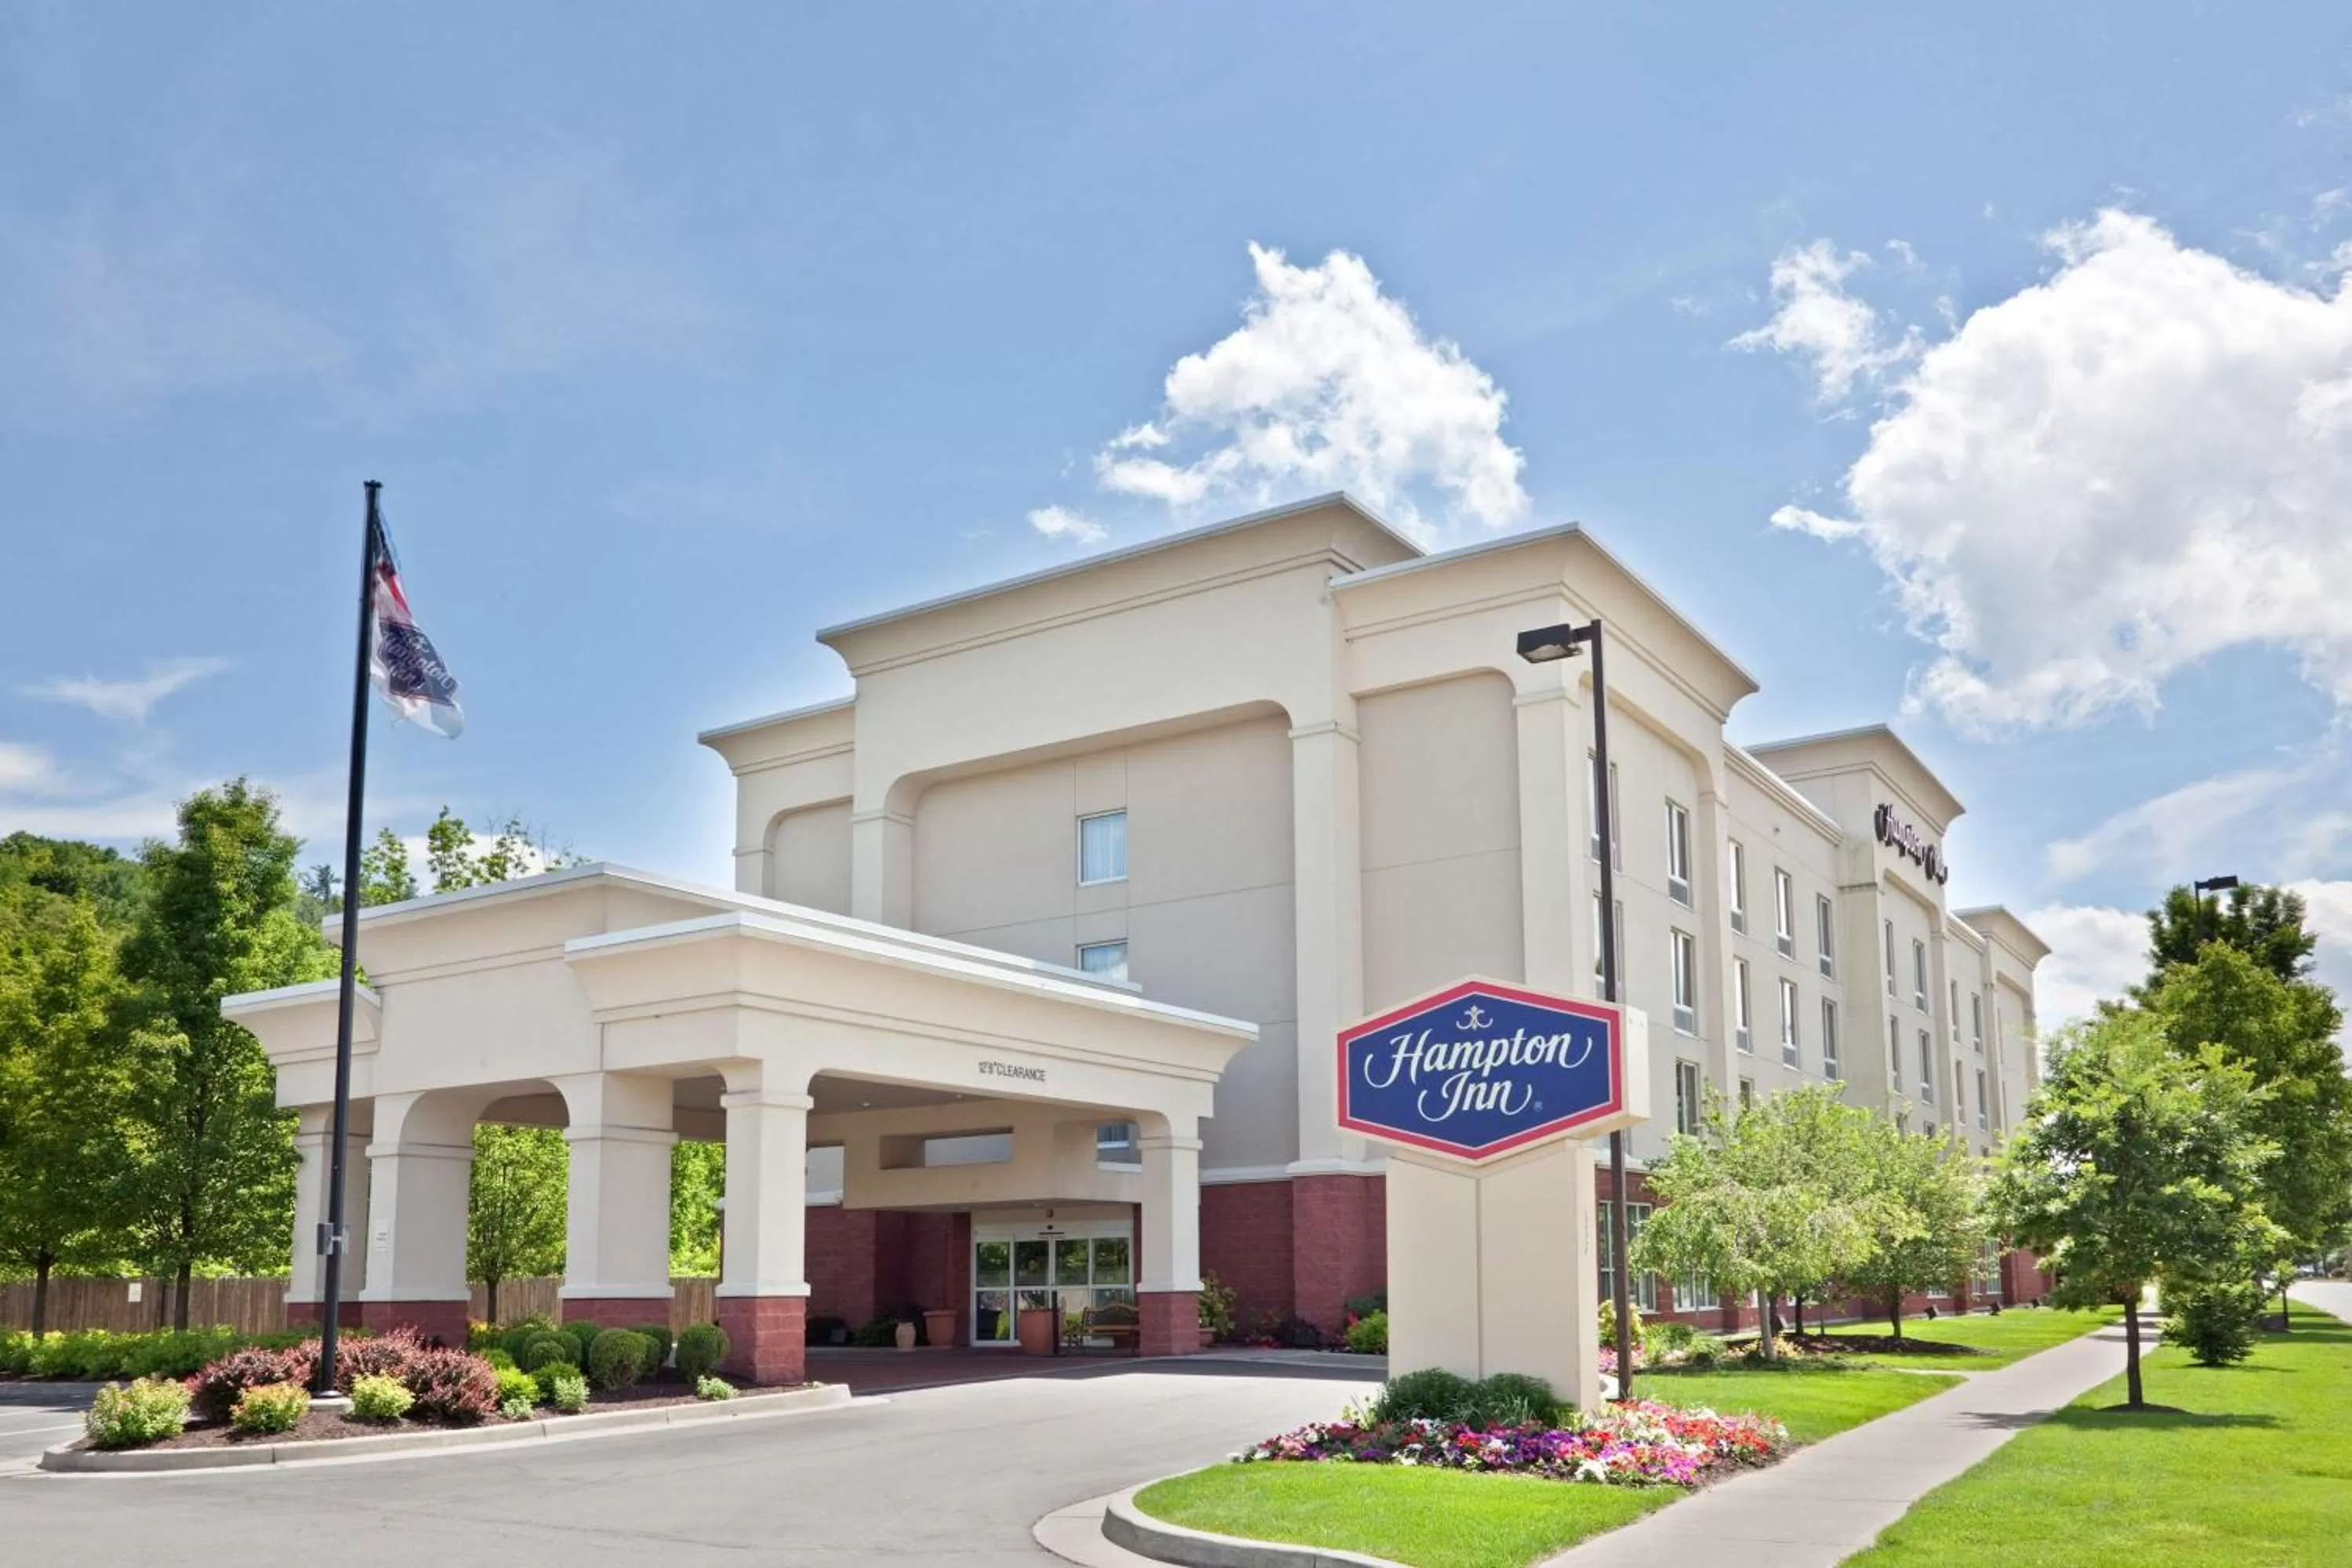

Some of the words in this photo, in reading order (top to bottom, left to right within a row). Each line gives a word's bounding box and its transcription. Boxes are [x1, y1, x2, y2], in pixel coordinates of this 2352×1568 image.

[996, 1062, 1047, 1082] CLEARANCE
[1364, 1028, 1592, 1088] Hampton
[1417, 1070, 1533, 1122] Inn
